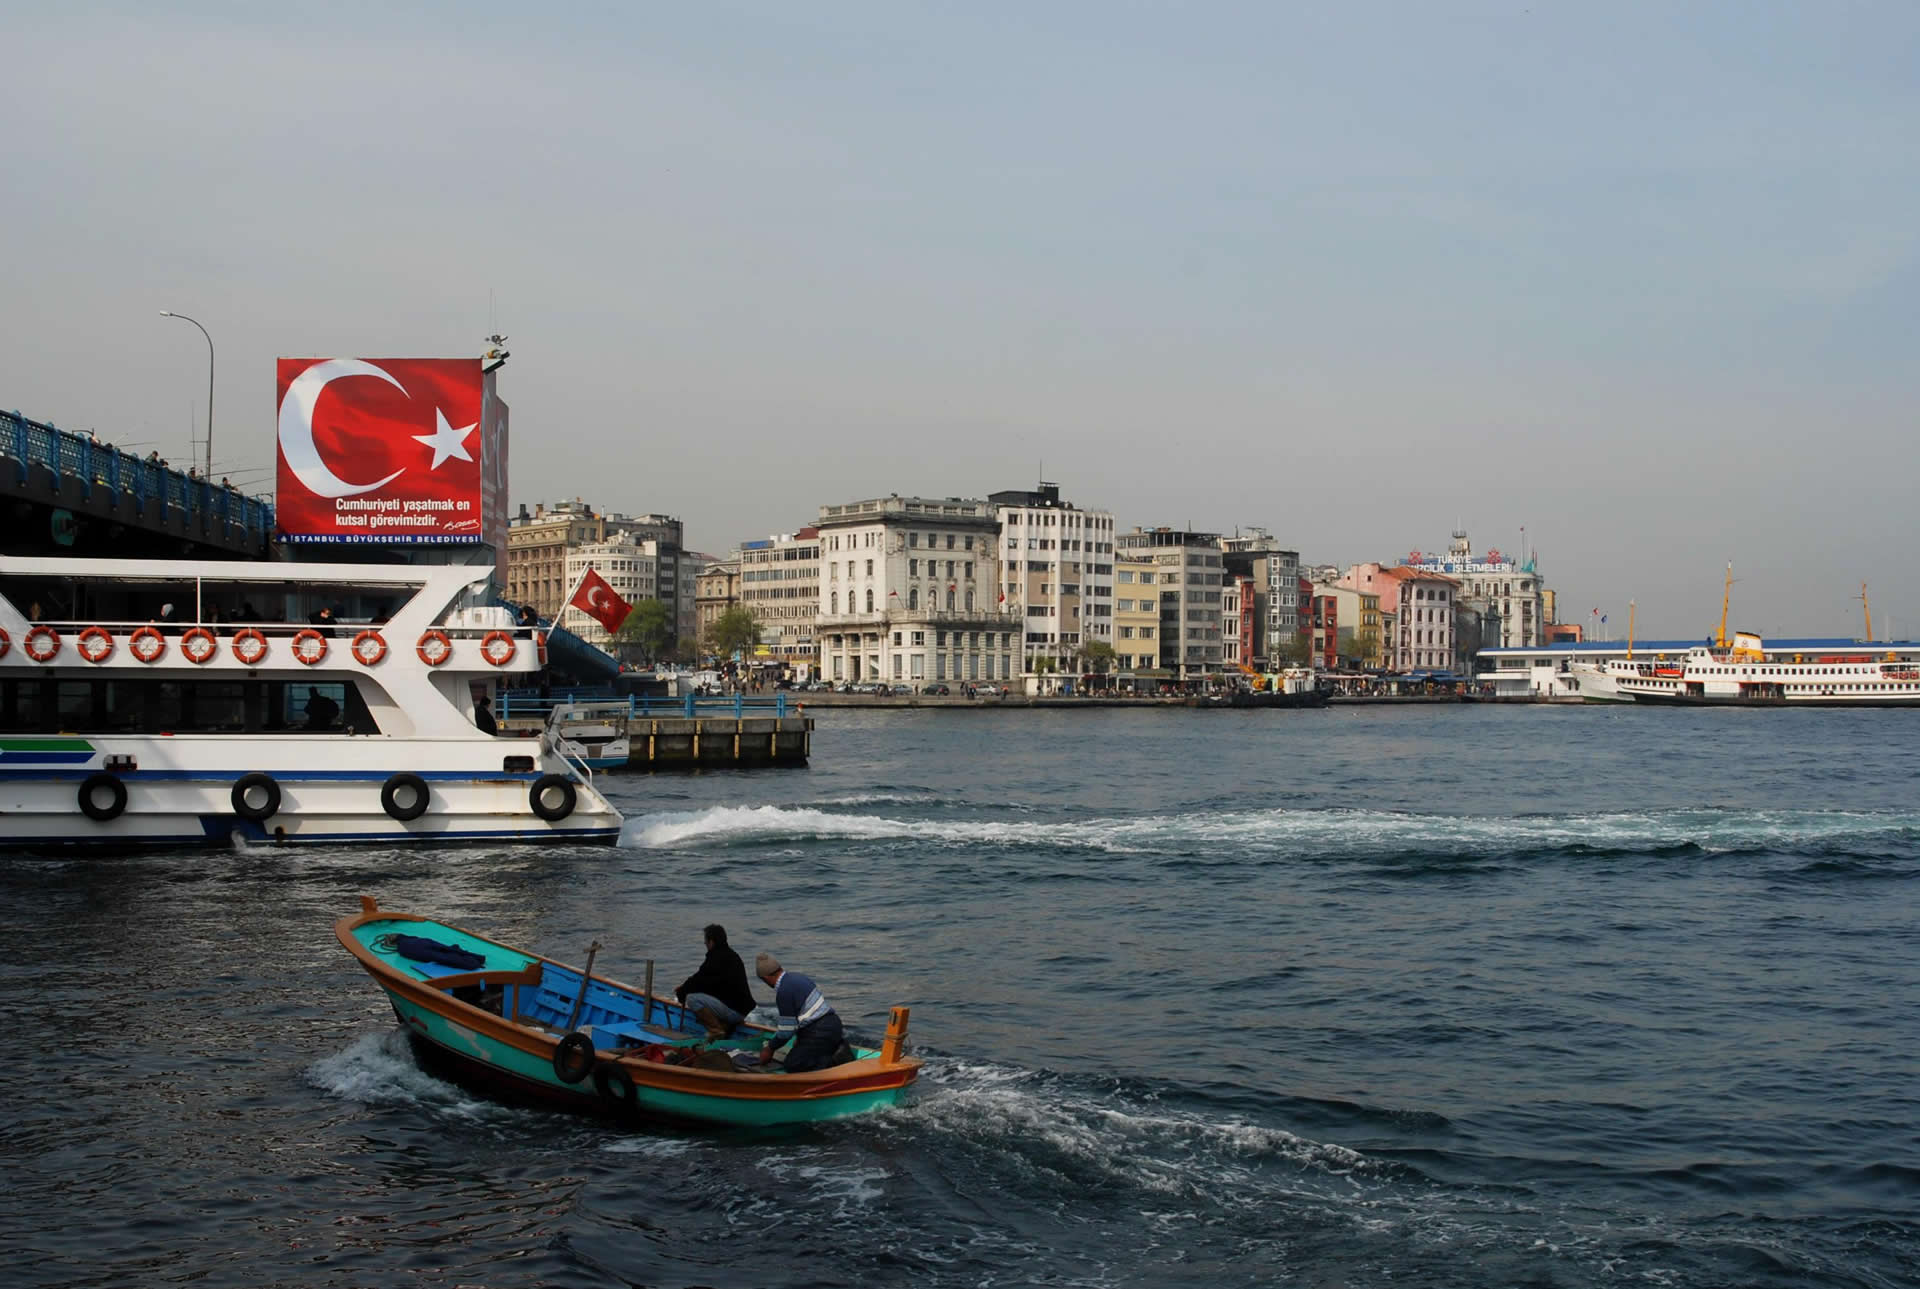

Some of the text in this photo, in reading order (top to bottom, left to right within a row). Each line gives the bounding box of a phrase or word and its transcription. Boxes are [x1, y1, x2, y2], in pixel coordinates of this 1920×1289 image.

[336, 498, 470, 512] Cumhuriyeti yaşatmak en
[335, 514, 368, 526] kutsal
[370, 514, 440, 528] görevimizdir.
[290, 534, 341, 543] İSTANBUL
[417, 534, 478, 543] BELEDİYESİ
